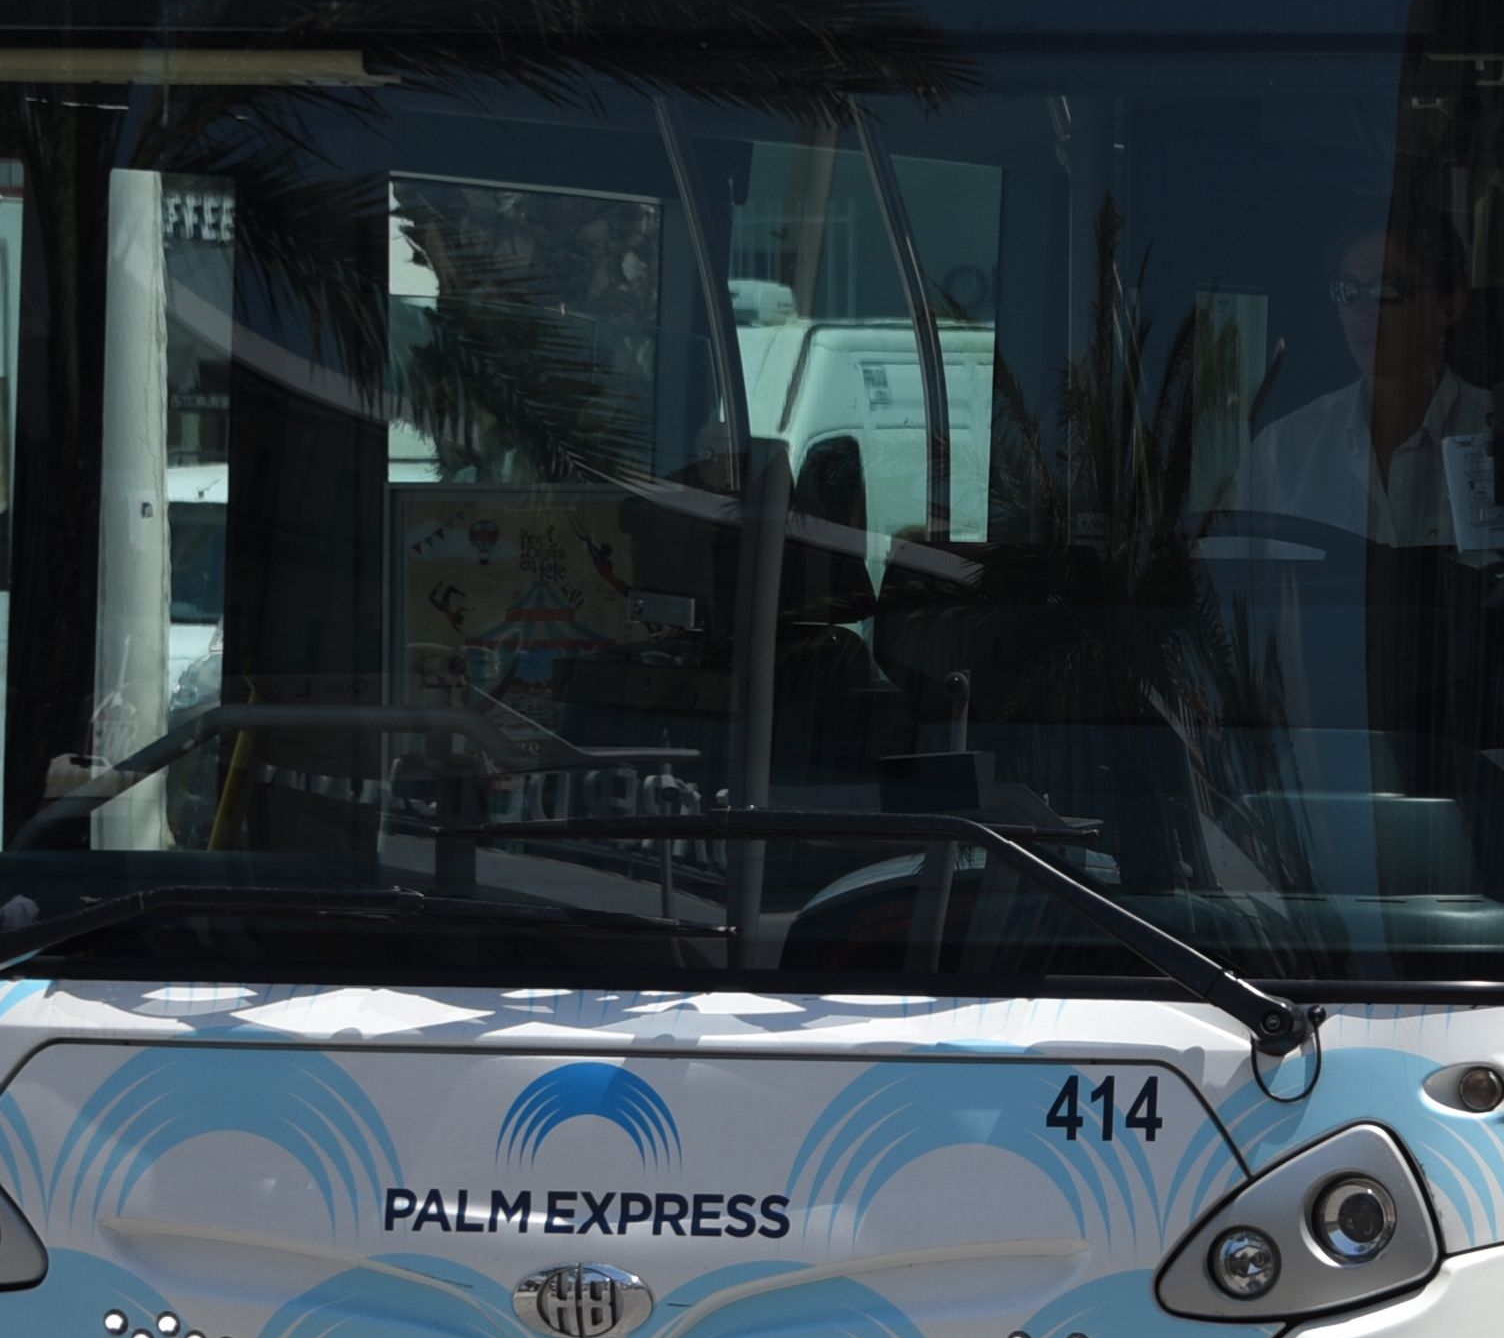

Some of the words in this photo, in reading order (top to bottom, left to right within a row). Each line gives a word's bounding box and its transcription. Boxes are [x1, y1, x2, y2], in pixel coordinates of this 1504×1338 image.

[1045, 1074, 1164, 1142] 414
[384, 1187, 532, 1235] PALM
[545, 1190, 791, 1240] EXPRESS
